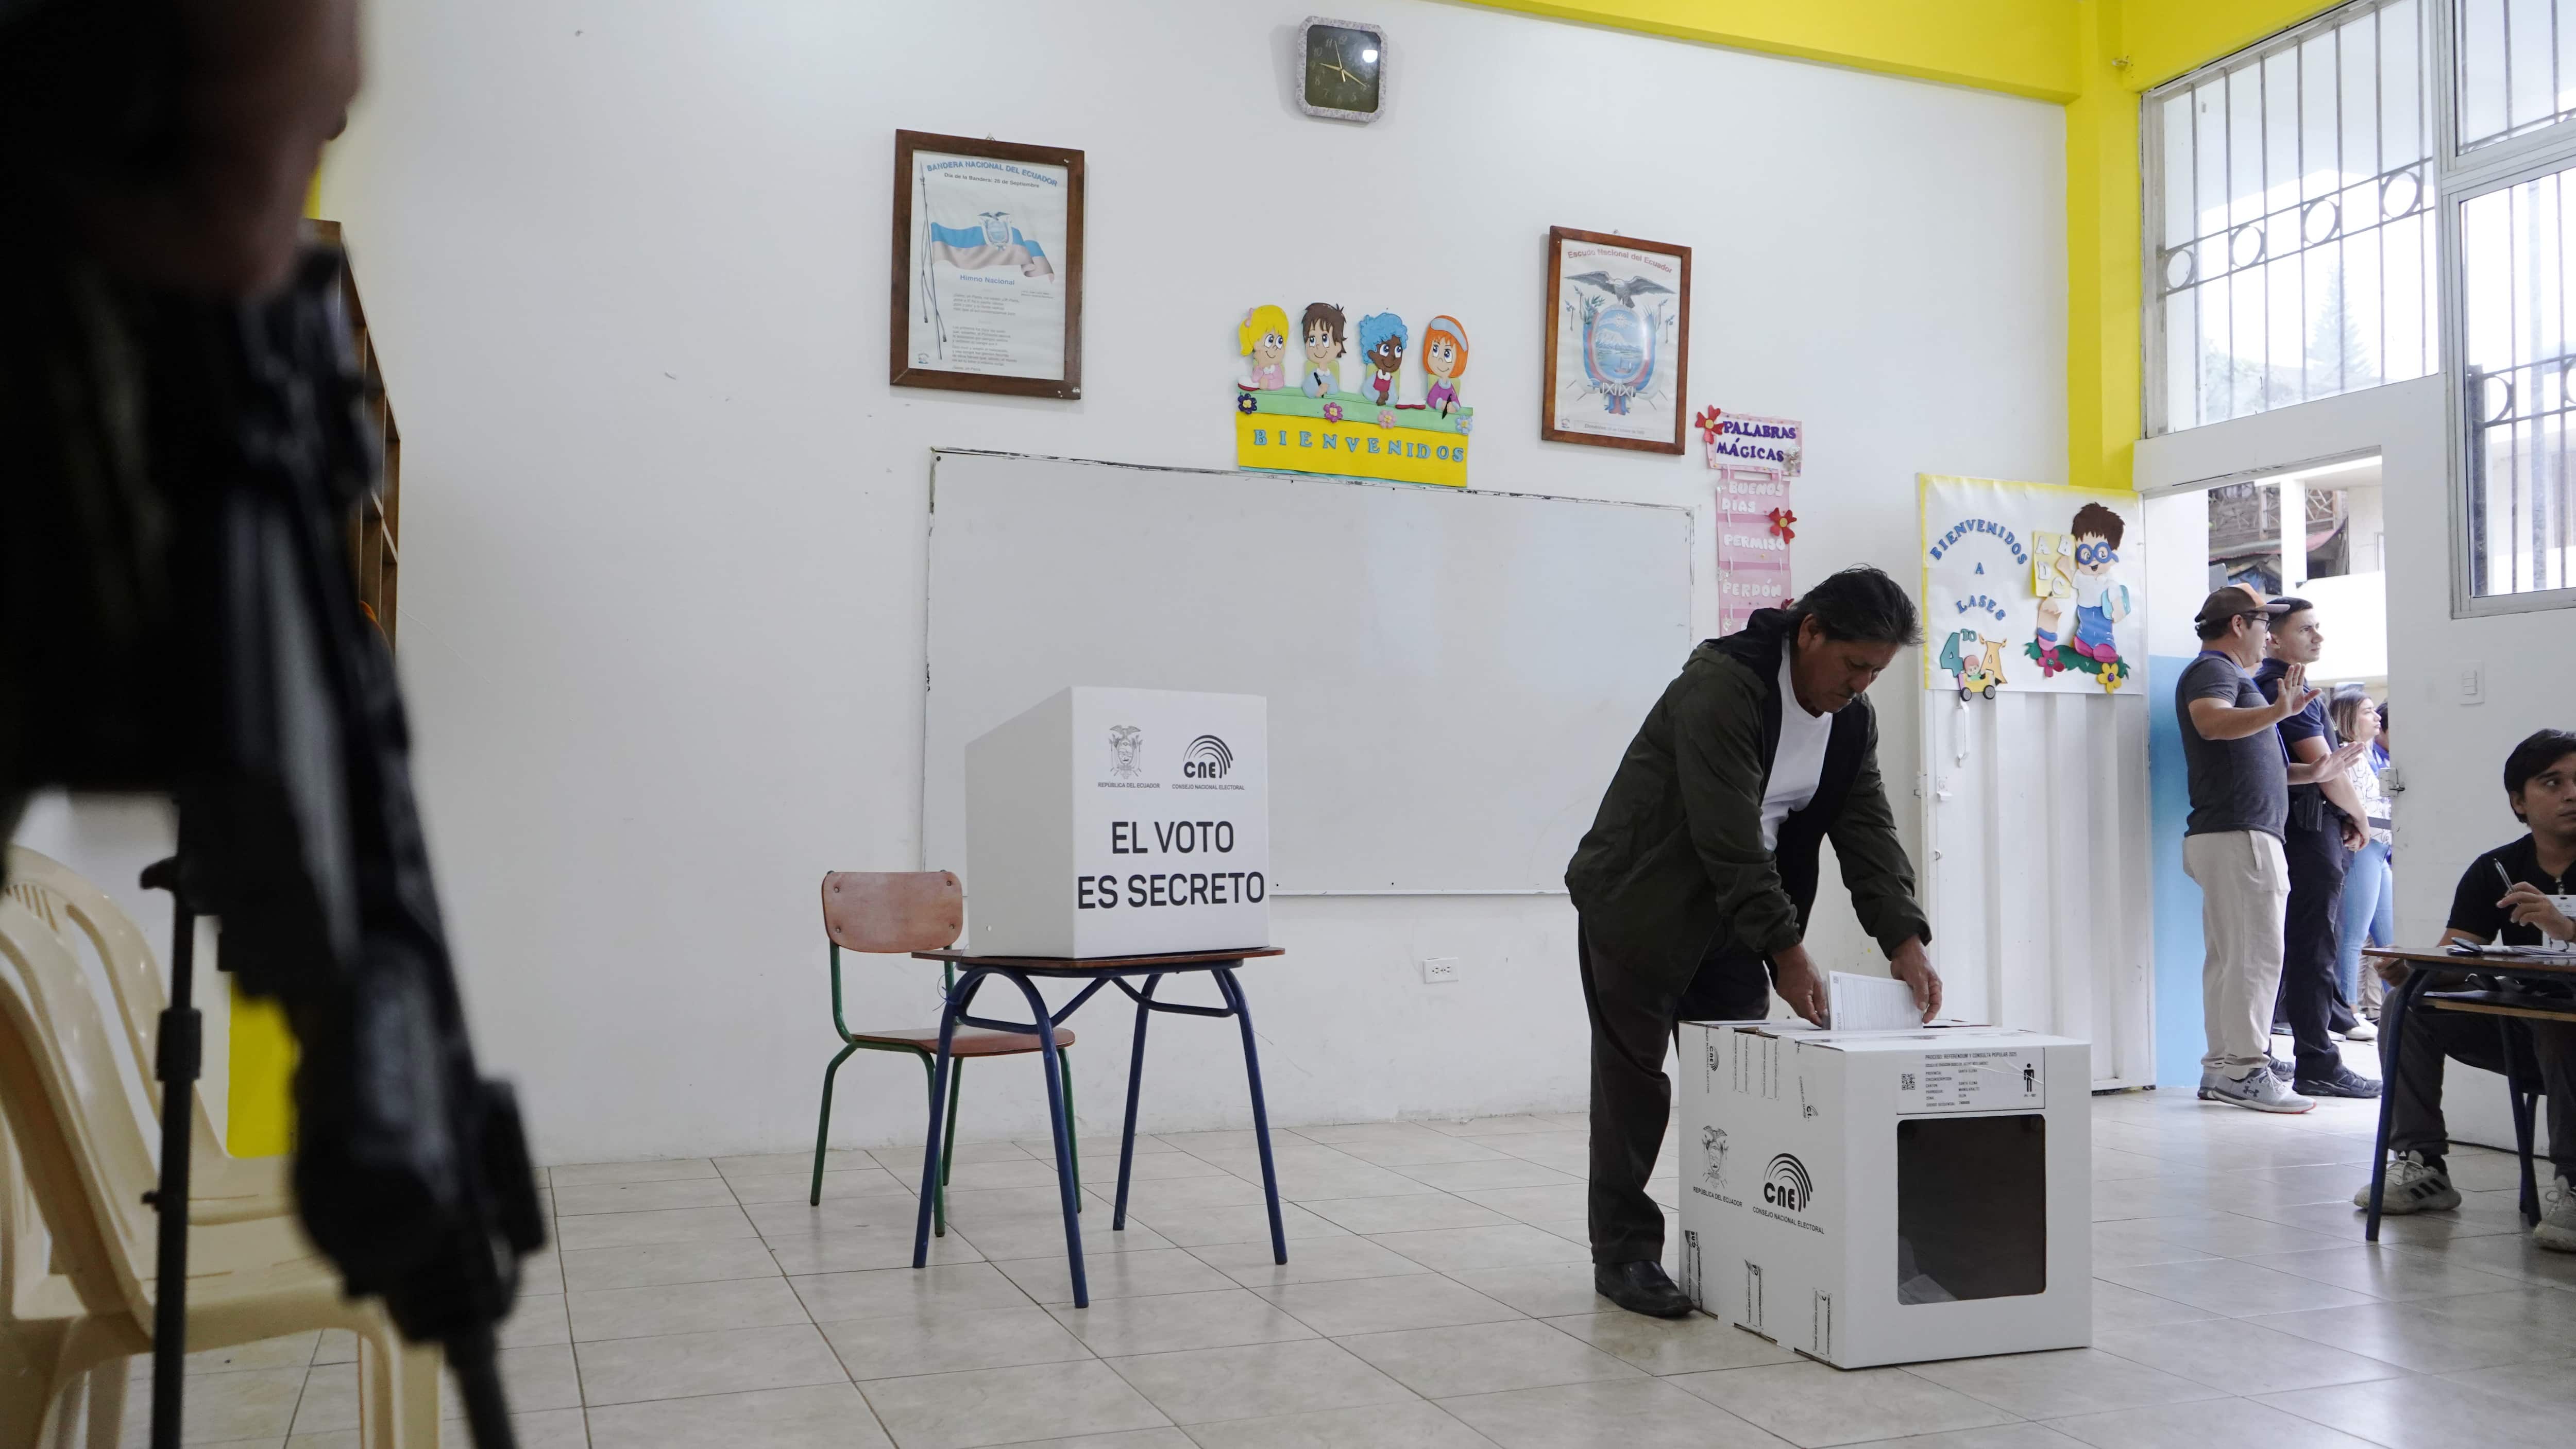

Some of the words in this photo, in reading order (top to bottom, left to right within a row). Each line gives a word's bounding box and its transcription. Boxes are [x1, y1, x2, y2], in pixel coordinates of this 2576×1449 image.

[927, 161, 963, 172] BANDERA
[965, 161, 1004, 171] NACIONAL
[1006, 165, 1020, 174] DEL
[1022, 169, 1058, 187] ECUADOR
[1010, 180, 1040, 189] Septiembre
[1568, 249, 1596, 259] Escudo
[1597, 249, 1629, 259] Nacional
[1644, 257, 1672, 273] Ecuador
[985, 277, 1015, 285] Nacional
[1722, 421, 1797, 439] PALABRAS
[1253, 429, 1464, 462] BIENVENIDOS
[1717, 438, 1784, 463] MÁGICAS
[1729, 481, 1784, 497] BUENOS
[1724, 534, 1786, 551] PERMISO
[1930, 519, 2028, 565] BIENVENIDOS
[2036, 536, 2050, 555] A
[2058, 535, 2073, 556] B
[1975, 562, 1984, 575] A
[2037, 561, 2051, 580] D
[1722, 578, 1782, 598] PERDÓN
[1956, 595, 2006, 621] LASES
[1112, 821, 1148, 854] EL
[1154, 821, 1233, 853] VOTO
[1078, 875, 1118, 909] ES
[1128, 872, 1264, 907] SECRETO
[1693, 1186, 1715, 1199] REPÚBLICA
[1723, 1196, 1742, 1207] ECUADOR
[1753, 1206, 1773, 1218] CONSEJO
[1774, 1212, 1797, 1225] NACIONAL
[1798, 1220, 1824, 1234] ELECTORAL
